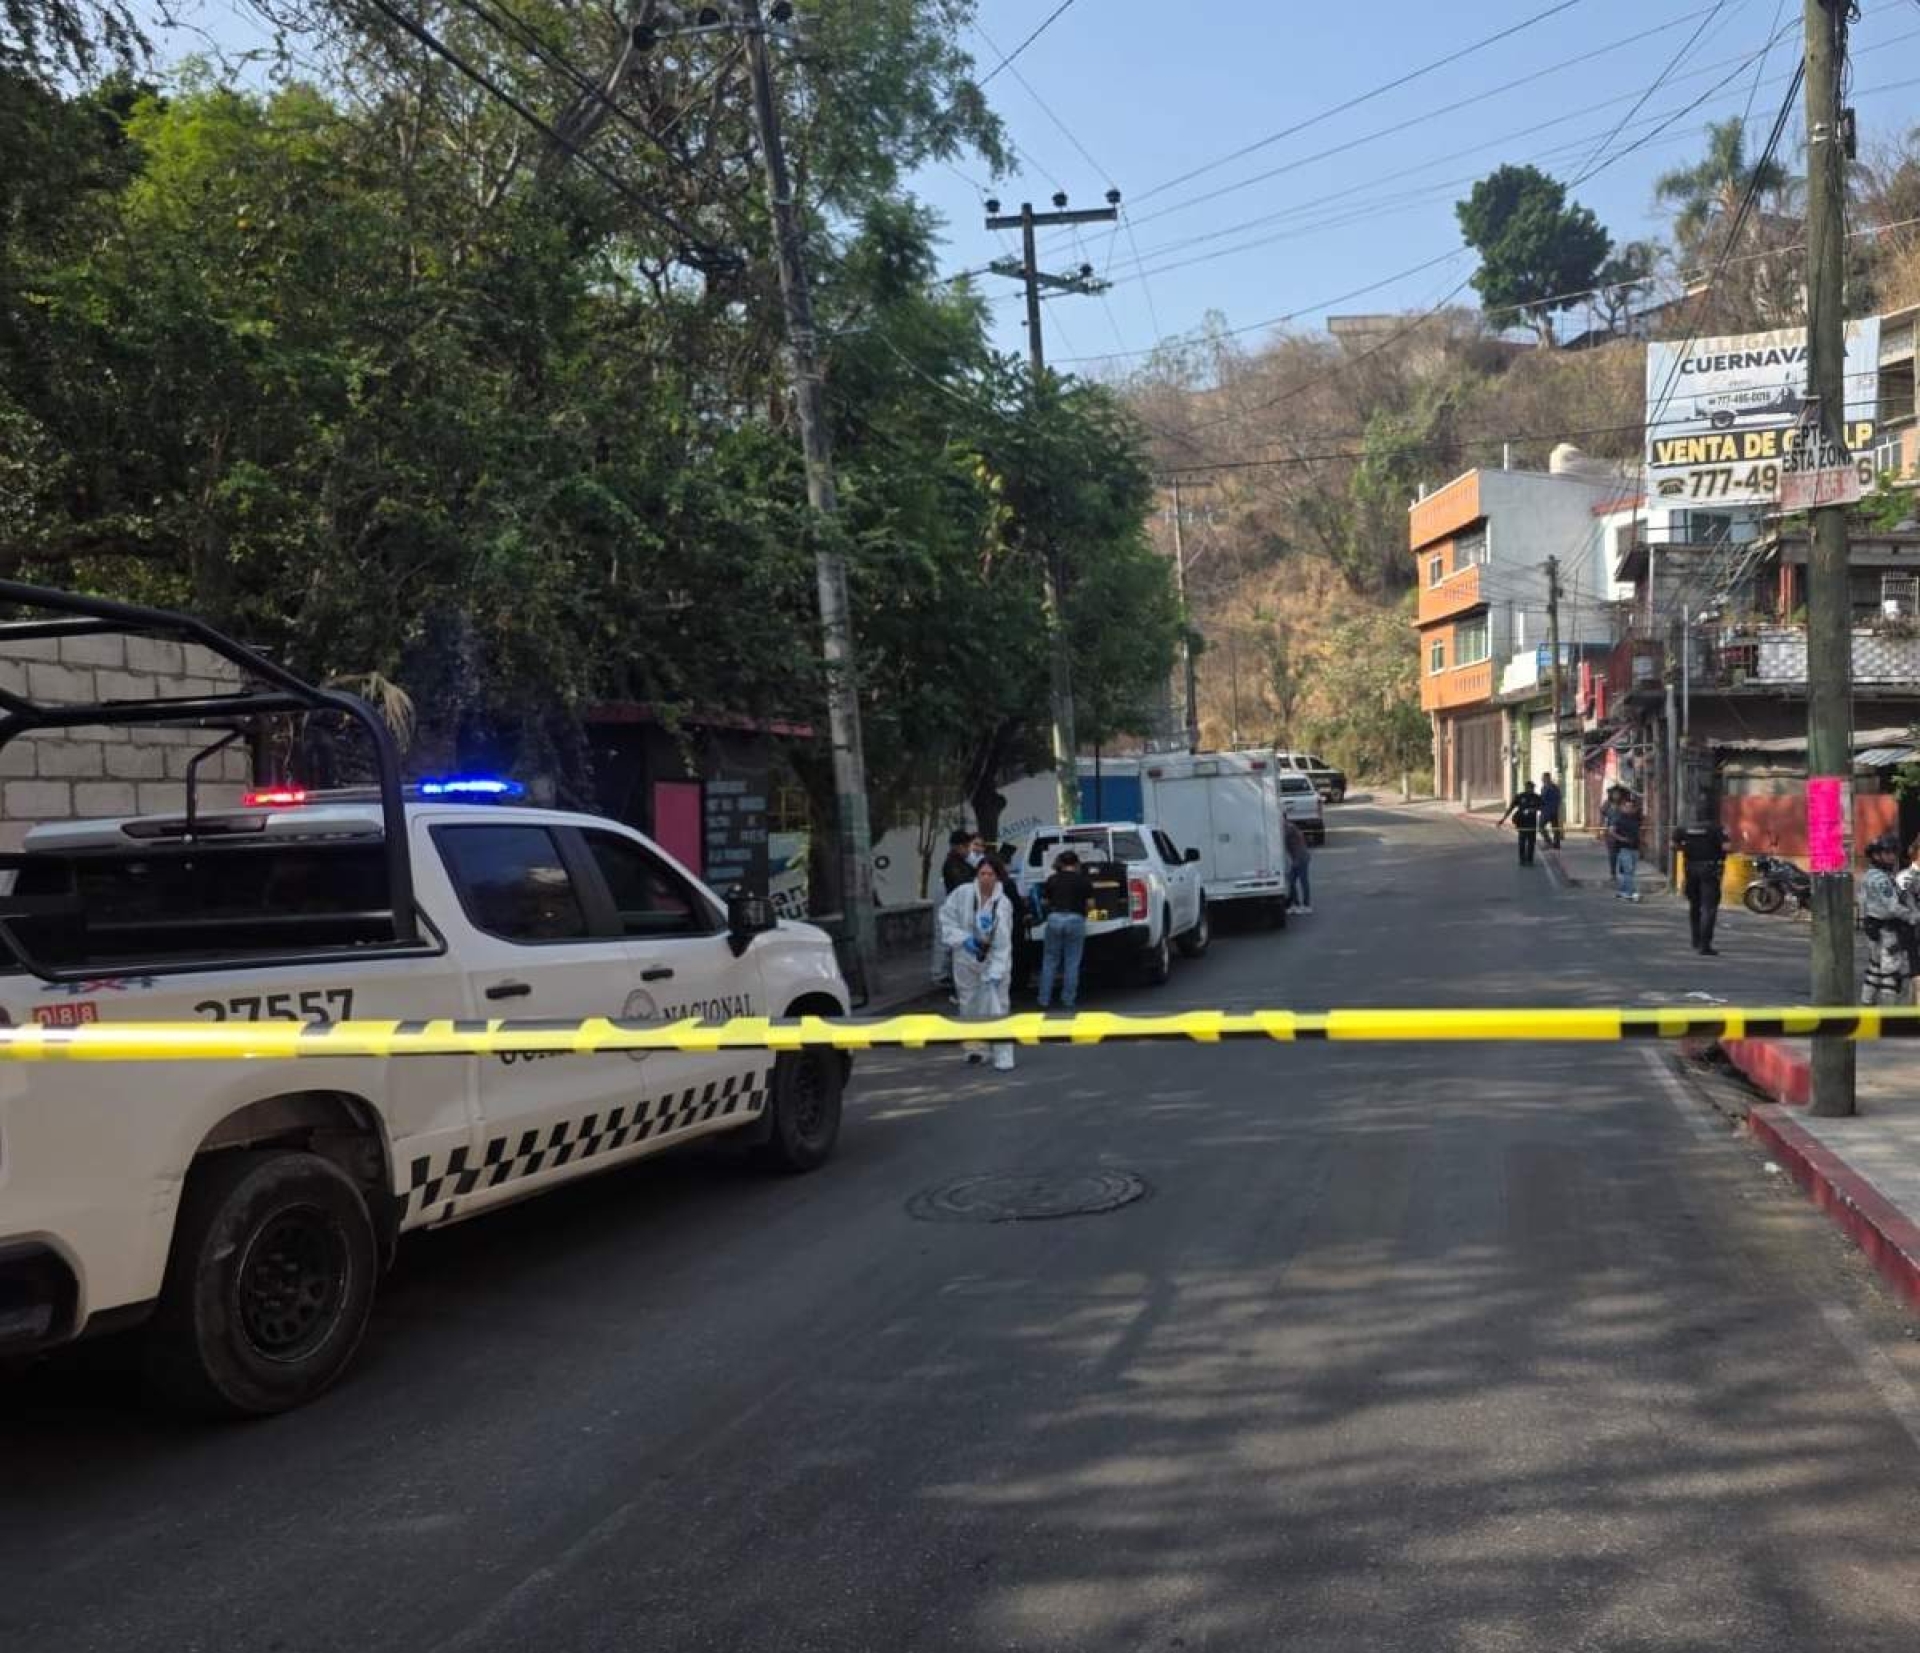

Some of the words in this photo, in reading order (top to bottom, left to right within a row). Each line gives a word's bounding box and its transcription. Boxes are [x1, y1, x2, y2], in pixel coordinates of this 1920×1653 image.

[1657, 436, 1738, 463] VENTA
[1745, 433, 1776, 457] DE
[1783, 448, 1815, 473] ESTA
